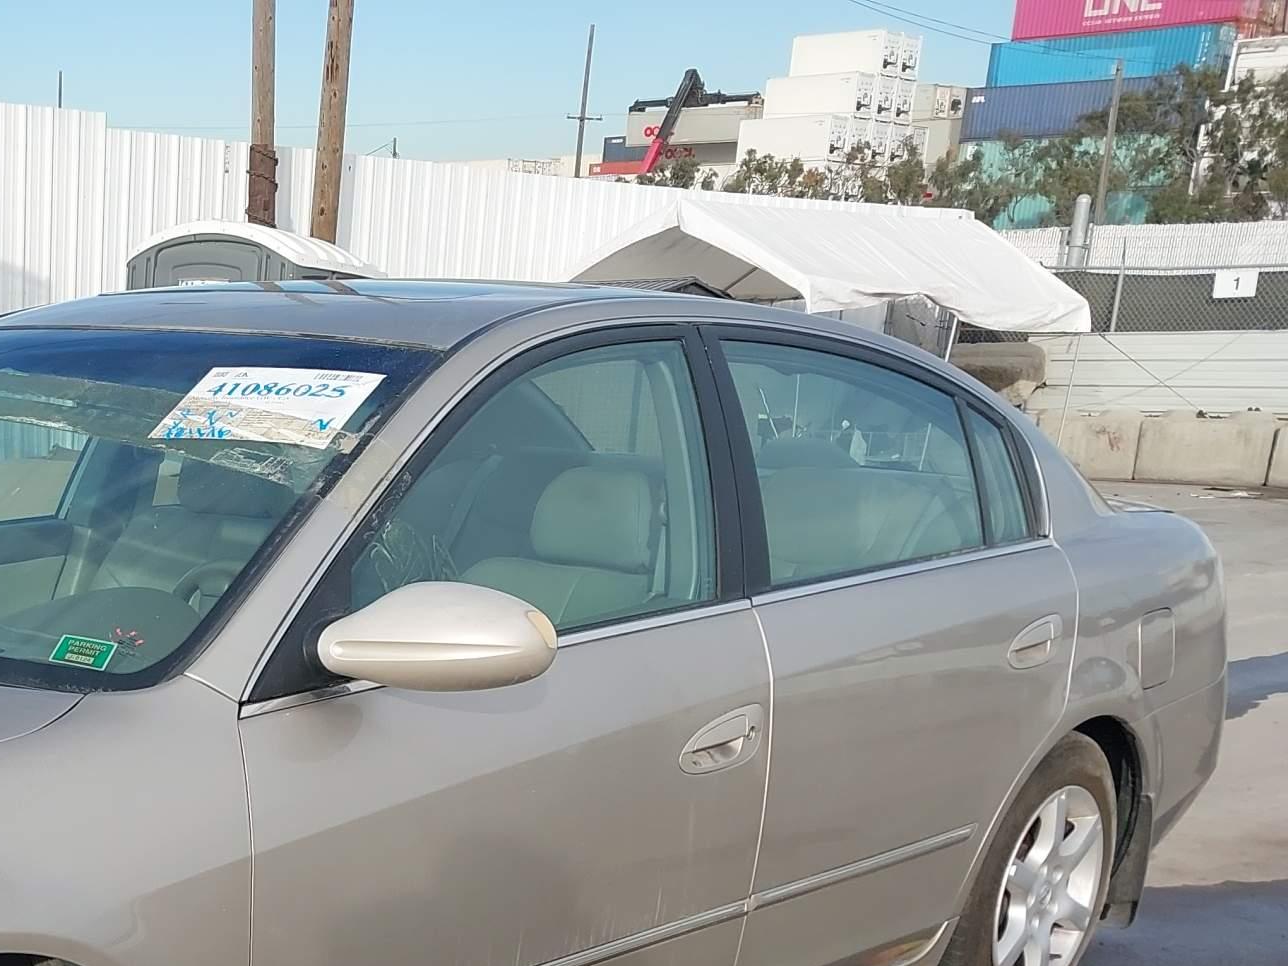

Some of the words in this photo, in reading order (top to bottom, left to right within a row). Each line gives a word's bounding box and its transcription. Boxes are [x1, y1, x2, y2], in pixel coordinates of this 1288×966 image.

[1233, 277, 1240, 290] 1
[206, 382, 350, 398] 41086025
[68, 640, 107, 651] PARKING
[68, 646, 101, 656] PERMIT
